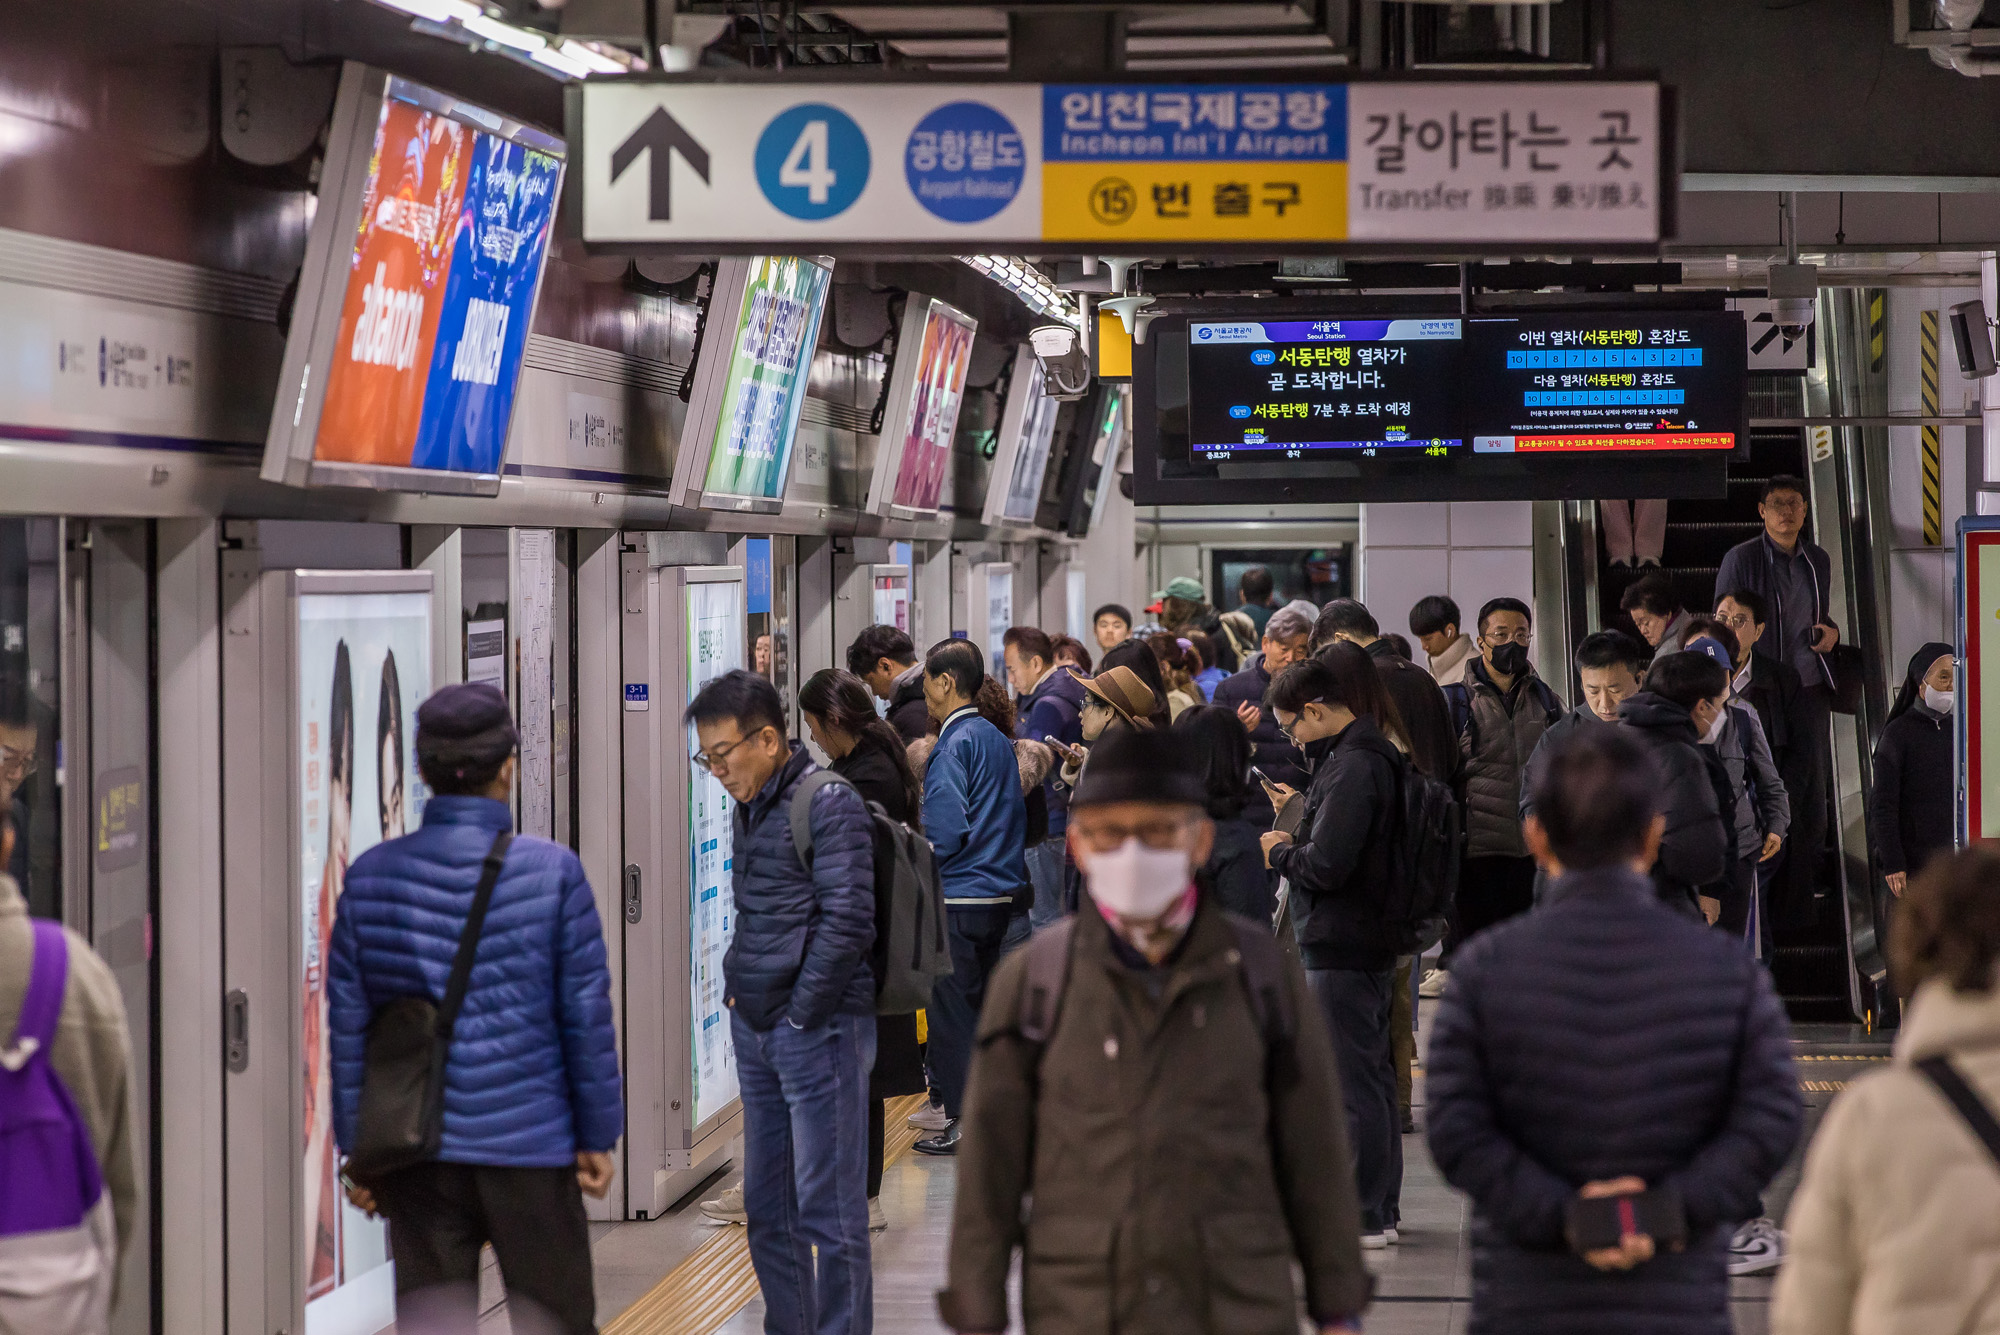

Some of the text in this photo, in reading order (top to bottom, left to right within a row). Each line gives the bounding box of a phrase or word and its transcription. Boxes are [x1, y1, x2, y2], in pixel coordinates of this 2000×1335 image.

[1062, 92, 1330, 131] 인천국제공항
[911, 131, 1024, 171] 공항철도
[1062, 133, 1164, 155] Incheon
[1235, 133, 1329, 159] Airport
[1365, 110, 1641, 174] 갈아타는 곳
[779, 121, 836, 203] 4
[1152, 183, 1191, 217] 번
[1214, 182, 1301, 217] 출구
[1360, 182, 1470, 211] Transfer
[1312, 321, 1341, 332] 서울역
[1519, 328, 1691, 346] 이번 열차(서동탄행) 혼잡도
[1255, 346, 1408, 367] 일반 서동탄행 열차가
[1533, 355, 1540, 363] 9
[1553, 355, 1559, 363] 8
[1573, 355, 1579, 363] 7
[1611, 354, 1617, 362] 5
[1631, 354, 1637, 362] 4
[1650, 354, 1656, 362] 3
[1690, 353, 1695, 361] 1
[1268, 370, 1386, 391] 곧 도착합니다.
[1534, 372, 1676, 388] 다음 열차(서동탄행) 혼잡도
[1234, 401, 1412, 418] 일반 서동탄행 7분 후 도착 예정
[1362, 447, 1376, 457] 시청
[1425, 446, 1448, 457] 서울역
[630, 685, 643, 693] 3-1
